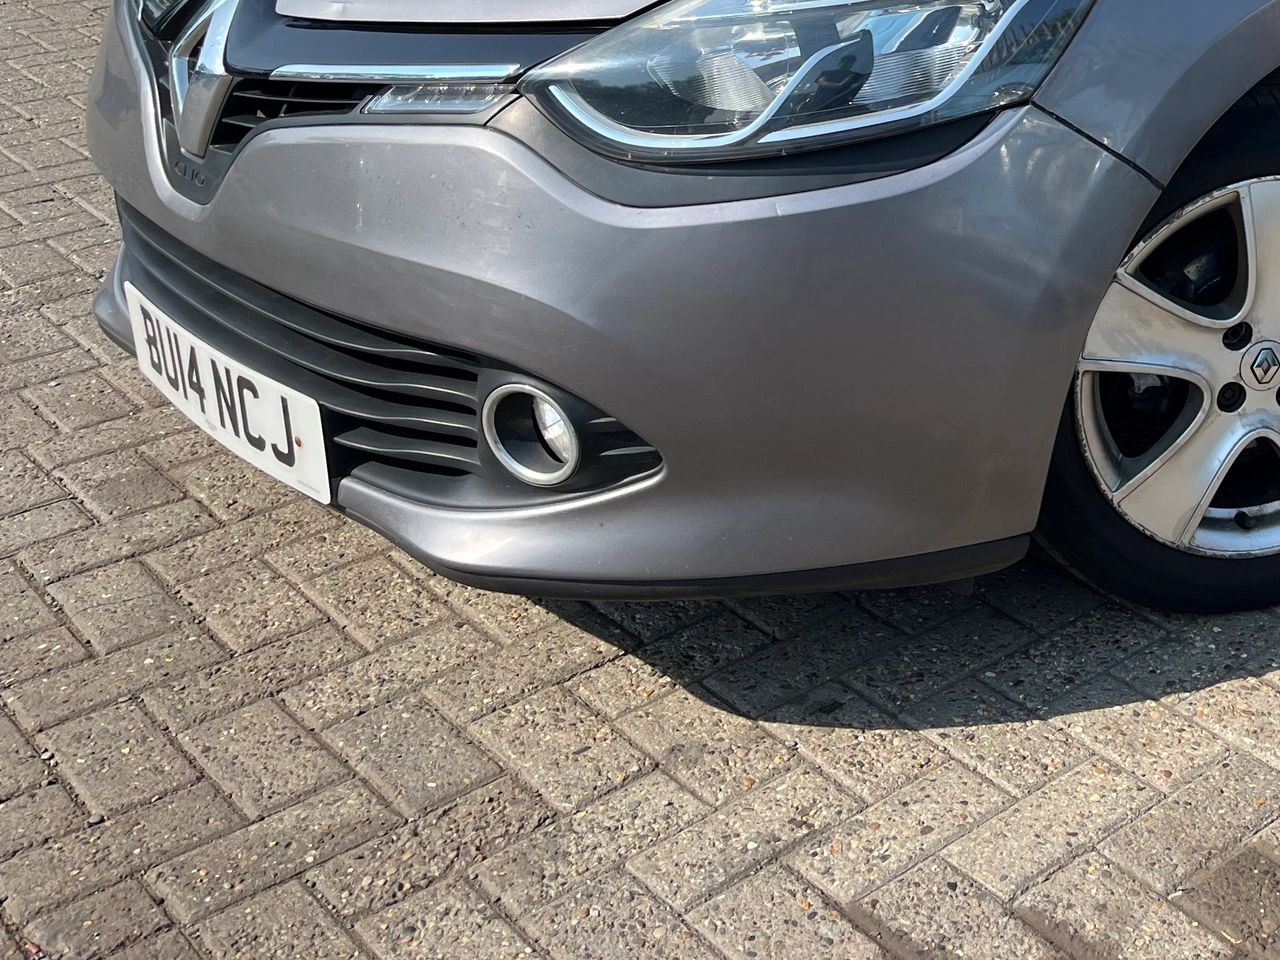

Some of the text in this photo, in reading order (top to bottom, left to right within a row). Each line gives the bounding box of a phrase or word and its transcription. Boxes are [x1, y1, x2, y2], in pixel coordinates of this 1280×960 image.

[175, 161, 206, 187] CLIO
[140, 303, 296, 468] BU14 NCJ
